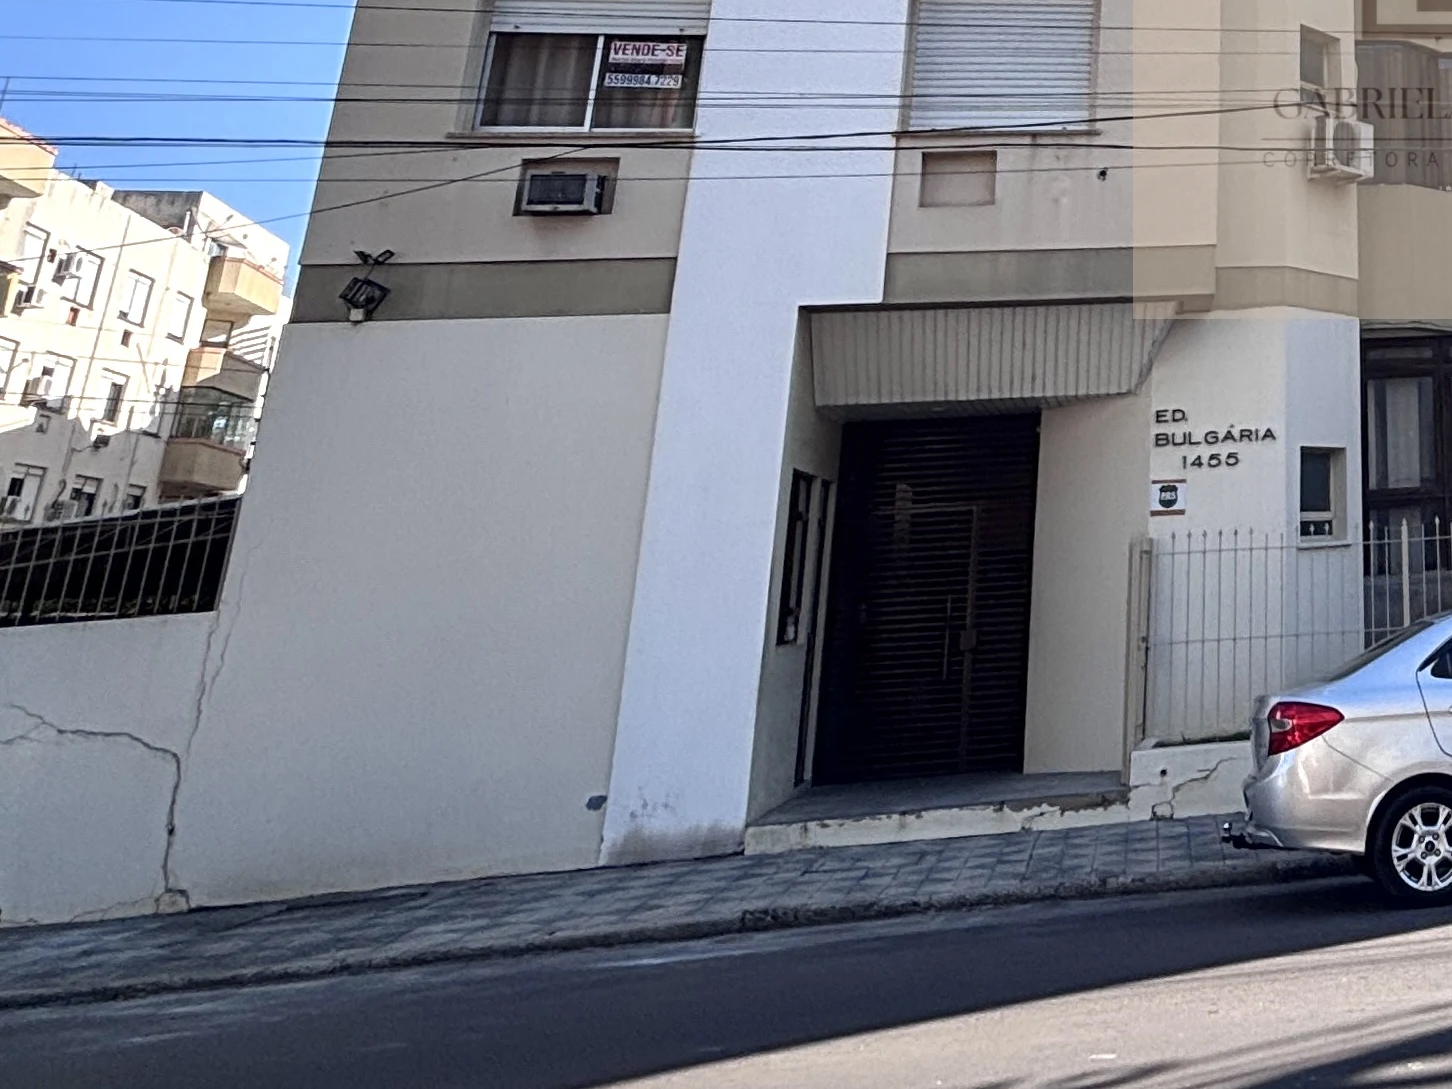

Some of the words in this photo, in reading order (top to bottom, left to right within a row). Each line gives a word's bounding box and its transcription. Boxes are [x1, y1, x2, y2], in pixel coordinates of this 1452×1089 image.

[612, 42, 685, 58] VENDE-SE
[1155, 409, 1188, 424] ED.
[1154, 424, 1277, 447] BULGÁRIA
[1182, 452, 1240, 469] 1455
